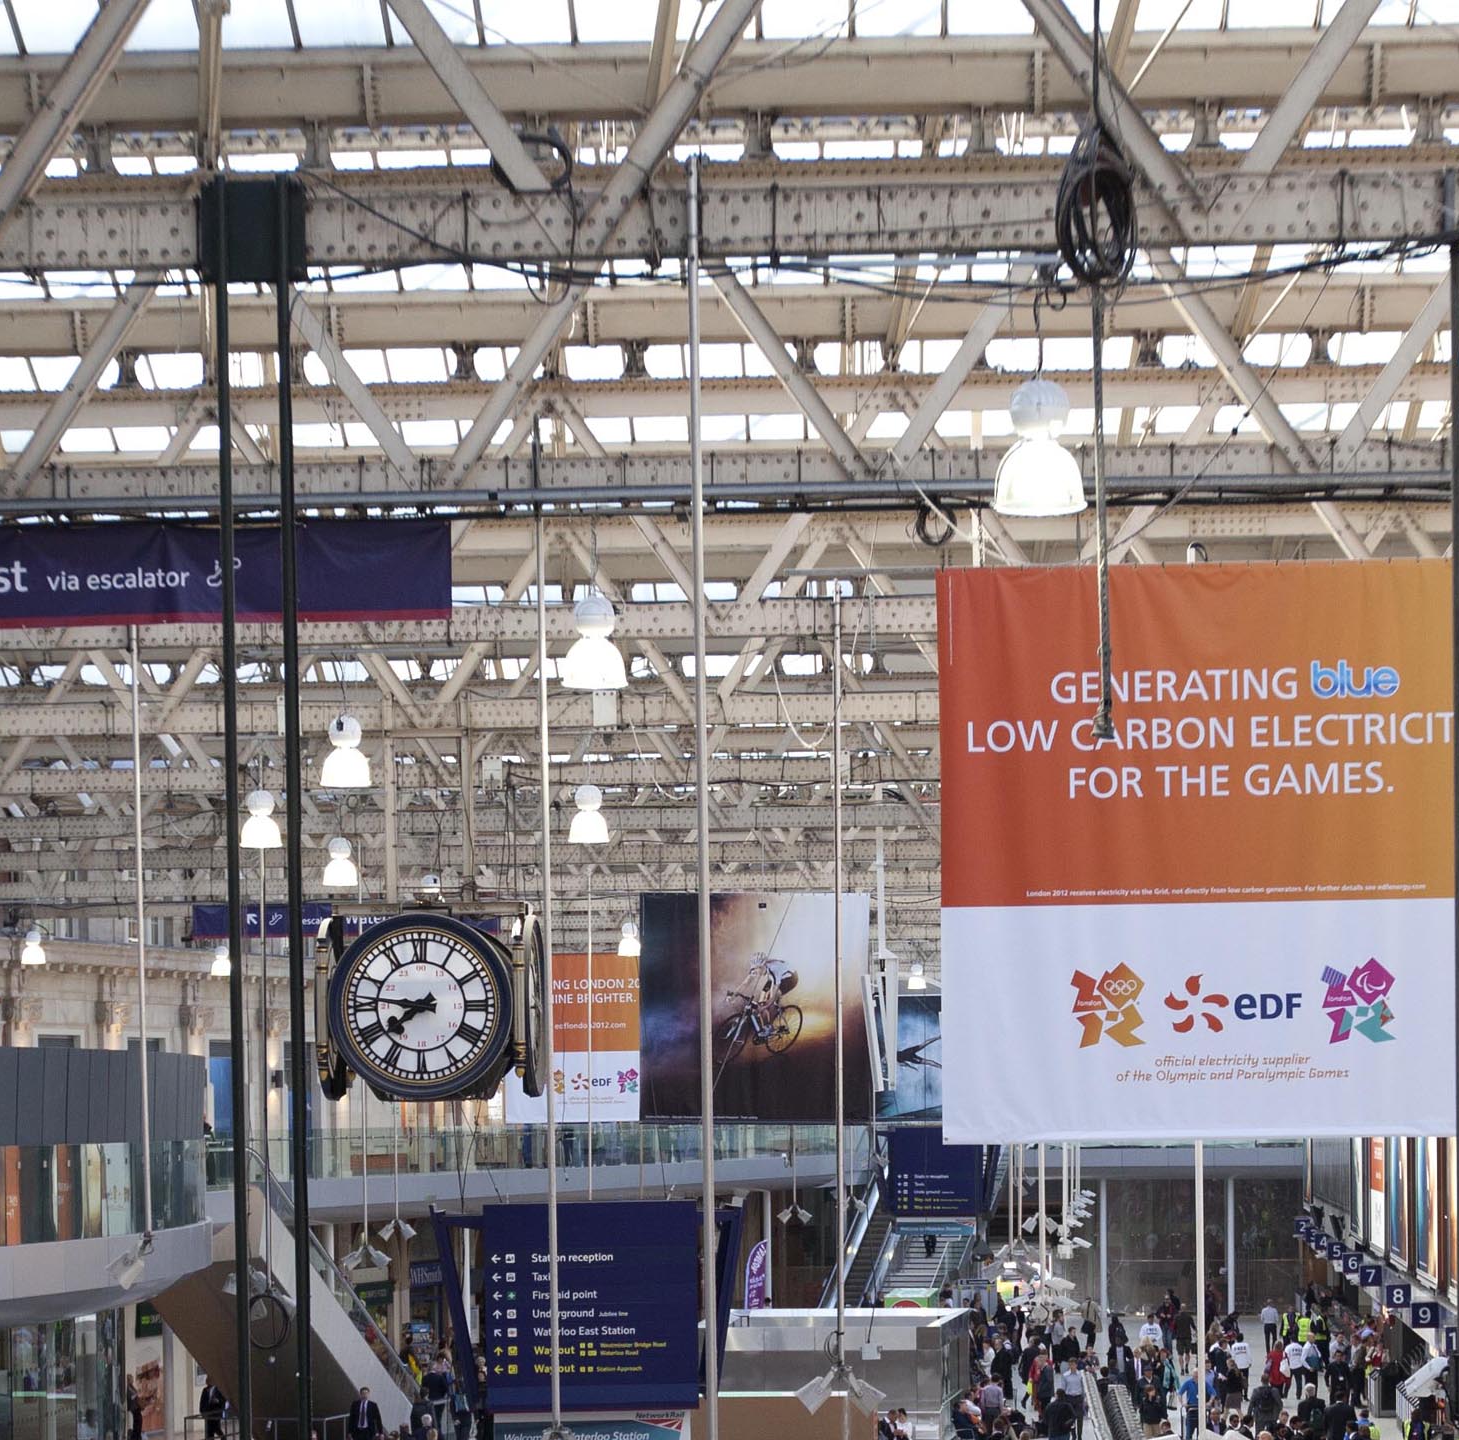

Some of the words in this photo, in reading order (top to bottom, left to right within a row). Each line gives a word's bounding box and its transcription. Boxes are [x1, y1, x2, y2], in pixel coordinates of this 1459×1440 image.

[46, 568, 80, 592] via
[86, 566, 190, 590] escalator
[1050, 665, 1298, 704] GENERATING
[1310, 659, 1400, 700] blue
[967, 719, 1058, 753] LOW
[1070, 716, 1235, 752] CARBON
[1069, 766, 1144, 799] FOR
[1155, 764, 1229, 797] THE
[1244, 760, 1395, 796] GAMES.
[553, 979, 570, 990] NG
[574, 978, 625, 990] LONDON
[628, 978, 640, 989] 20
[1154, 1054, 1195, 1067] official
[1198, 1053, 1260, 1067] electricity
[1262, 1053, 1311, 1069] supplier
[1116, 1070, 1130, 1083] of
[1132, 1069, 1152, 1082] the
[1155, 1068, 1206, 1083] Olympic
[1210, 1068, 1233, 1081] and
[1236, 1067, 1305, 1082] Paralympic
[1308, 1067, 1350, 1079] Games
[1299, 1221, 1307, 1232] 2
[1319, 1236, 1327, 1246] 4
[531, 1253, 566, 1263] Staton
[568, 1252, 614, 1263] reception
[1332, 1246, 1341, 1257] 5
[1348, 1257, 1358, 1270] 6
[1366, 1269, 1376, 1283] 7
[532, 1290, 550, 1300] Firs
[556, 1290, 570, 1300] aid
[572, 1290, 598, 1301] point
[1393, 1288, 1404, 1304] 8
[532, 1308, 594, 1319] Undrground
[1418, 1307, 1431, 1323] 9
[533, 1327, 577, 1337] Watrloo
[578, 1326, 599, 1336] East
[601, 1325, 636, 1336] Station
[557, 1346, 576, 1355] out
[557, 1364, 576, 1373] out
[612, 1431, 650, 1440] Station
